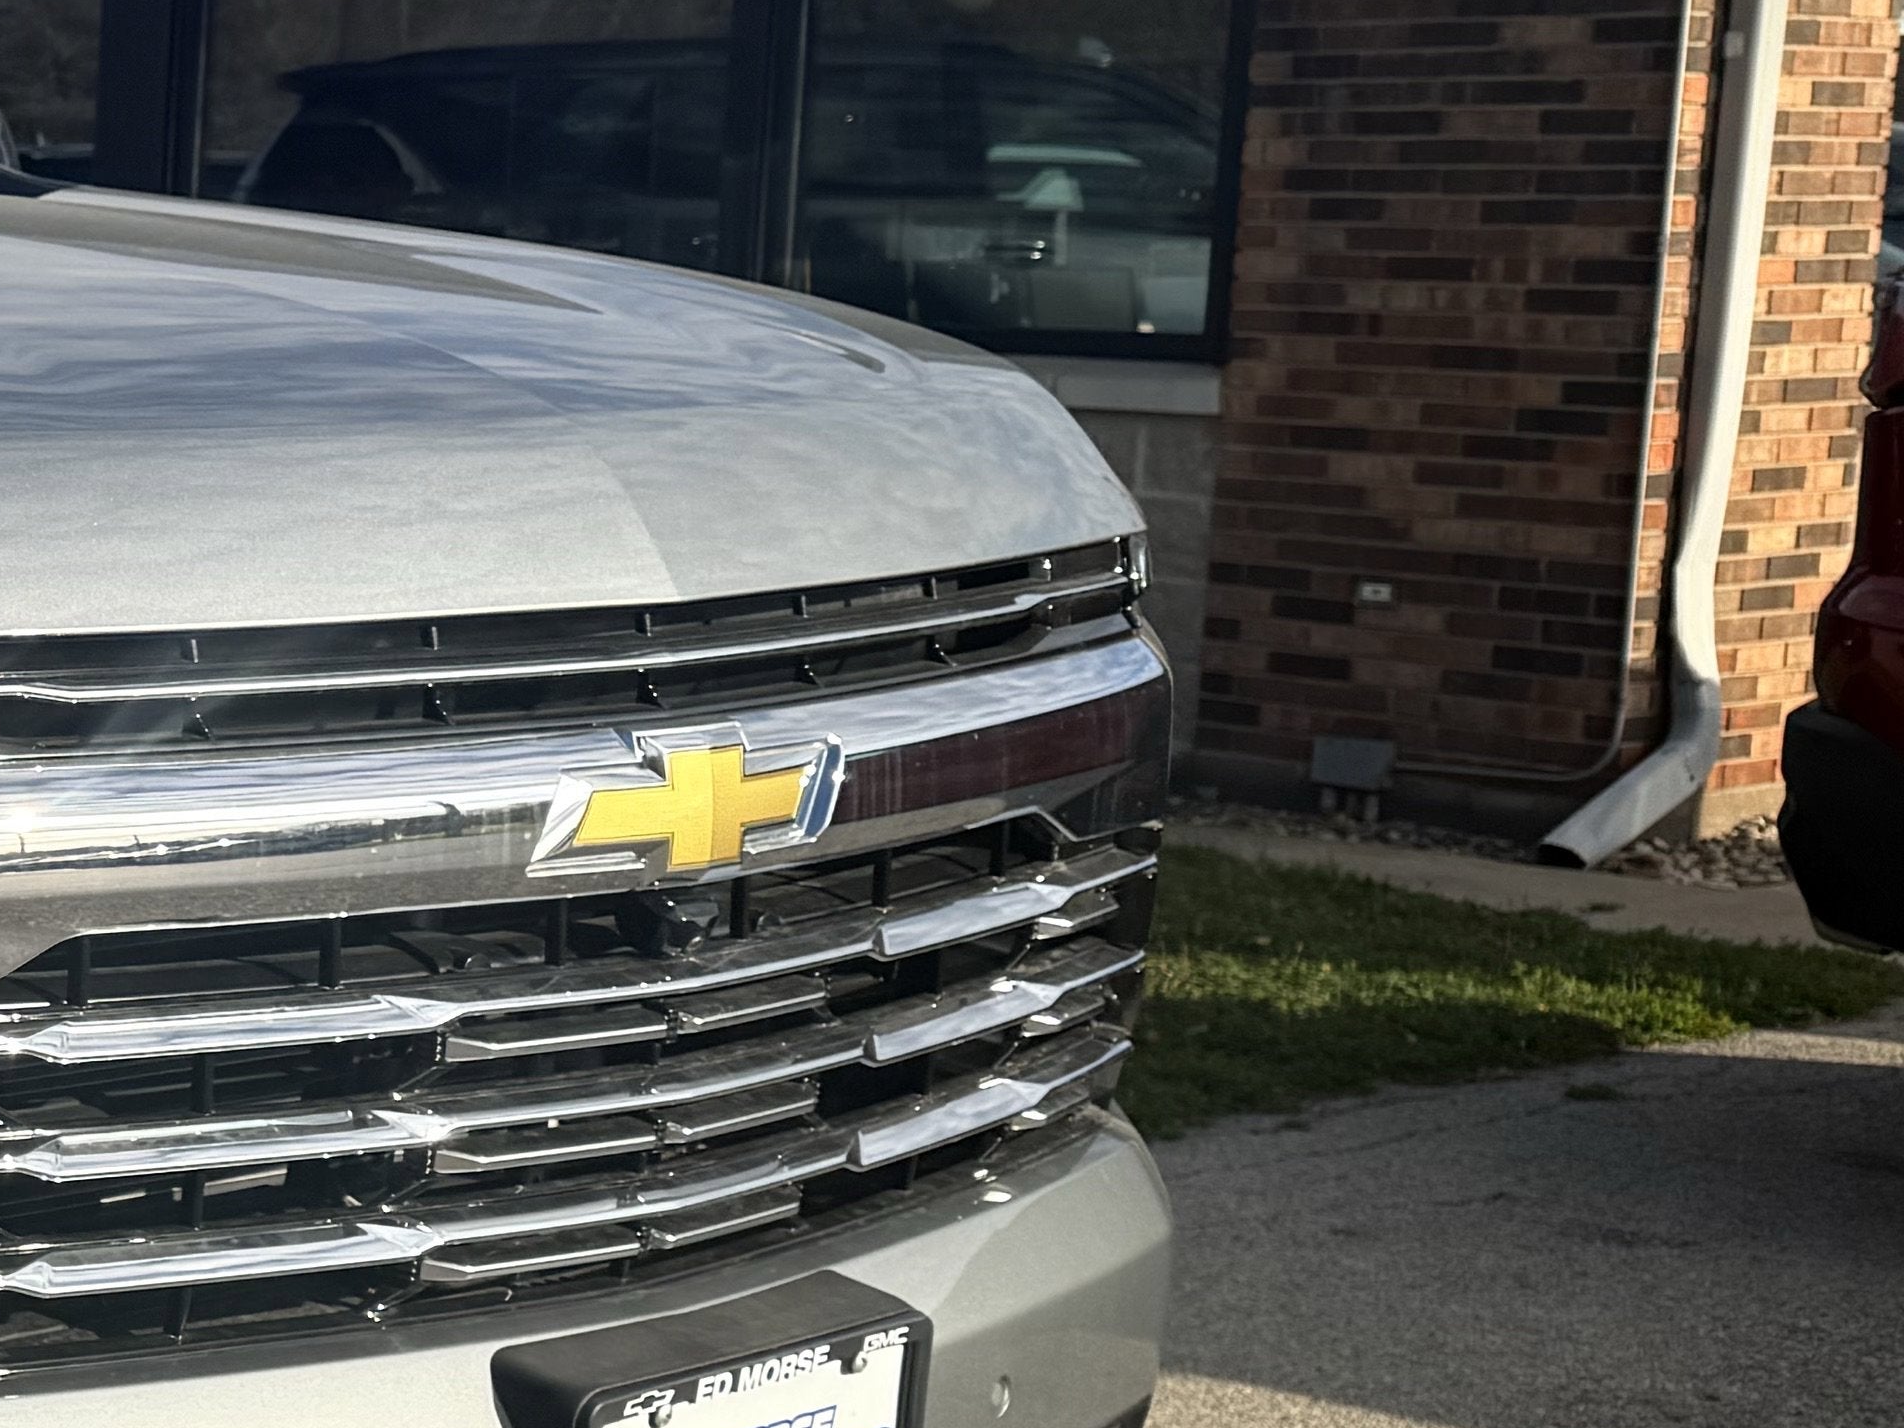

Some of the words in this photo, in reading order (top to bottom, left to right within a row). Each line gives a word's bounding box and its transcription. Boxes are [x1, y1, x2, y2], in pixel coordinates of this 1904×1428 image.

[862, 1326, 910, 1353] GMC
[695, 1371, 734, 1403] ED
[737, 1344, 830, 1396] MORSE
